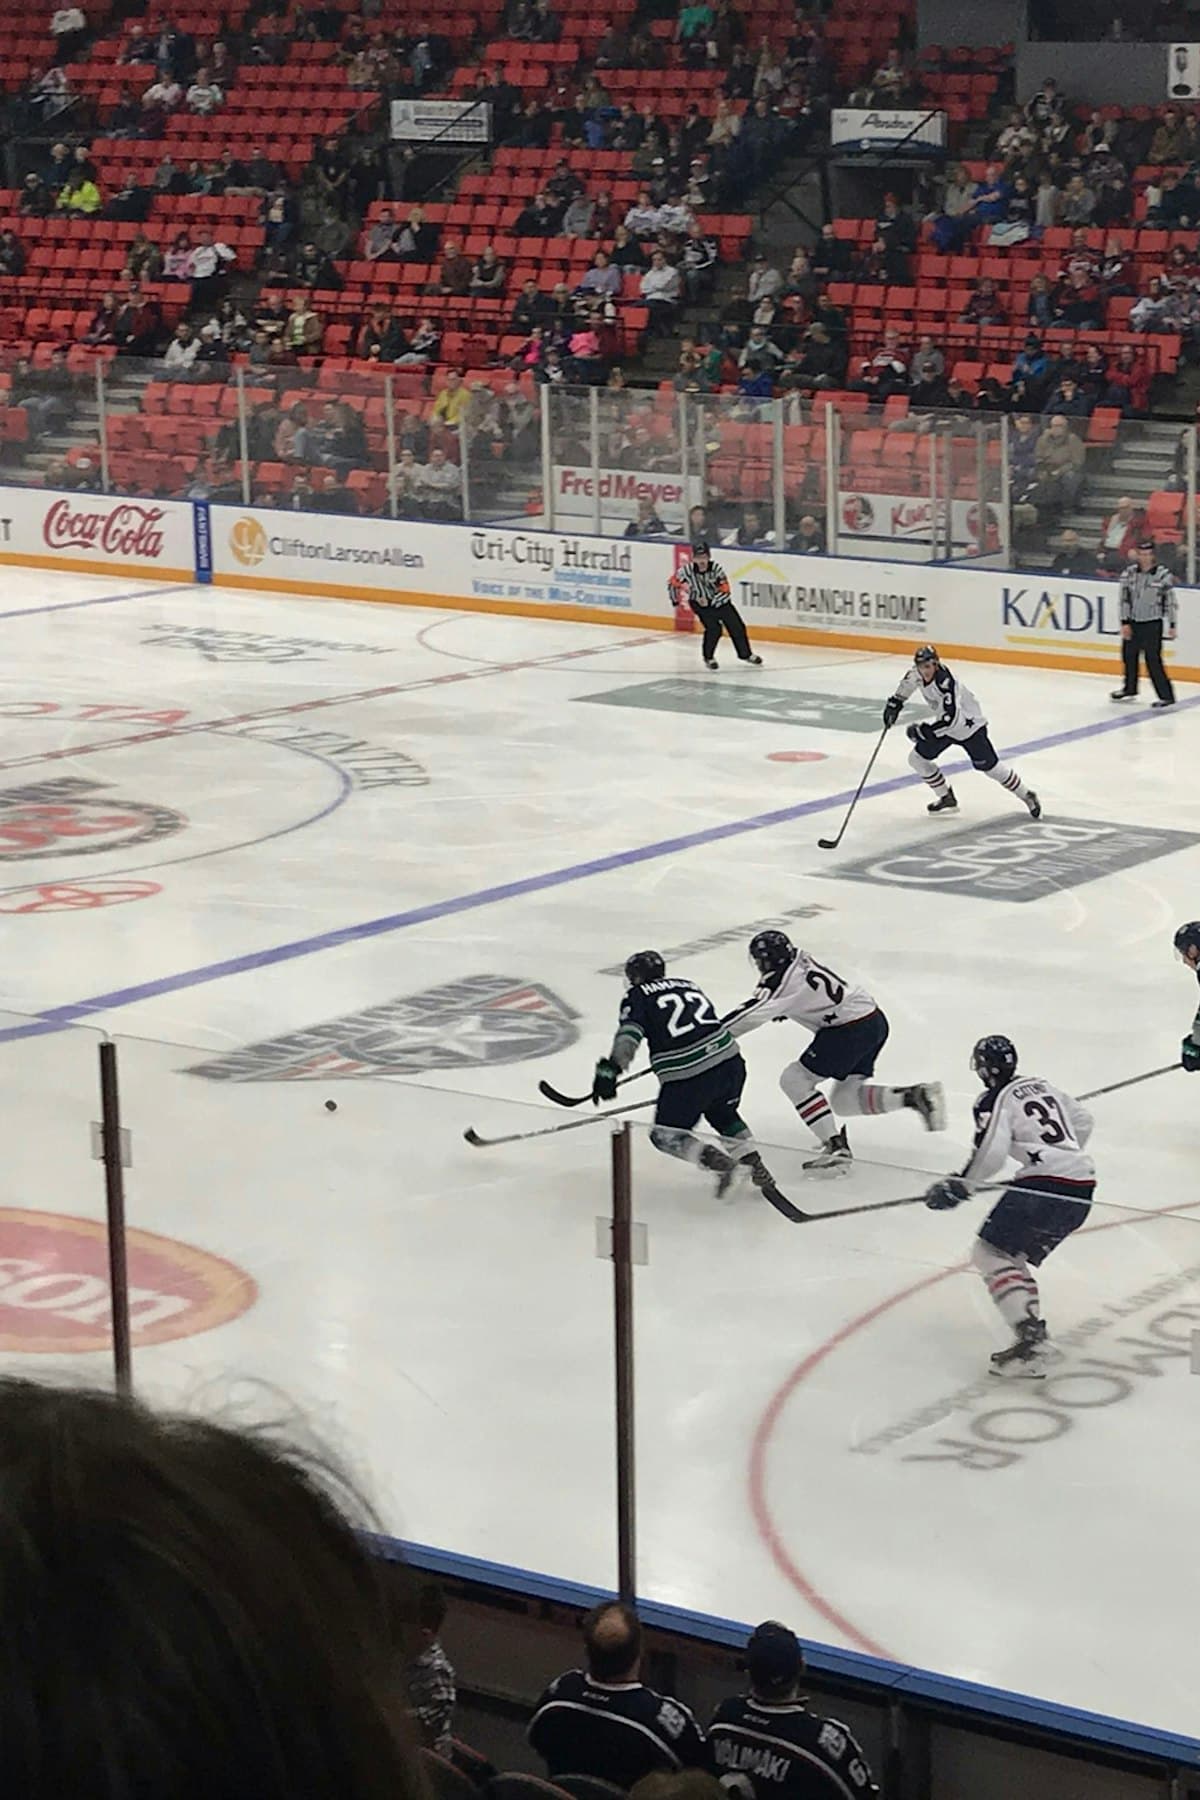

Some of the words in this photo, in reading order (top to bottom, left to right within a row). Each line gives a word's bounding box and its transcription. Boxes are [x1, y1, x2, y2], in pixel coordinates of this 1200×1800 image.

[560, 469, 611, 498] Fred
[614, 474, 683, 505] Meyer
[43, 500, 165, 558] Coca-Cola
[269, 536, 424, 569] CliftonLarsonAllen
[471, 531, 554, 573] Tri-City
[560, 539, 632, 573] Herald
[738, 580, 792, 610] THINK
[795, 585, 855, 617] RANCH
[859, 591, 872, 618] &
[875, 593, 928, 623] HOME
[1001, 586, 1121, 637] KADL
[238, 725, 431, 791] CENTER
[865, 822, 1121, 884] Gesa
[806, 955, 849, 1006] 2
[656, 991, 722, 1039] 22
